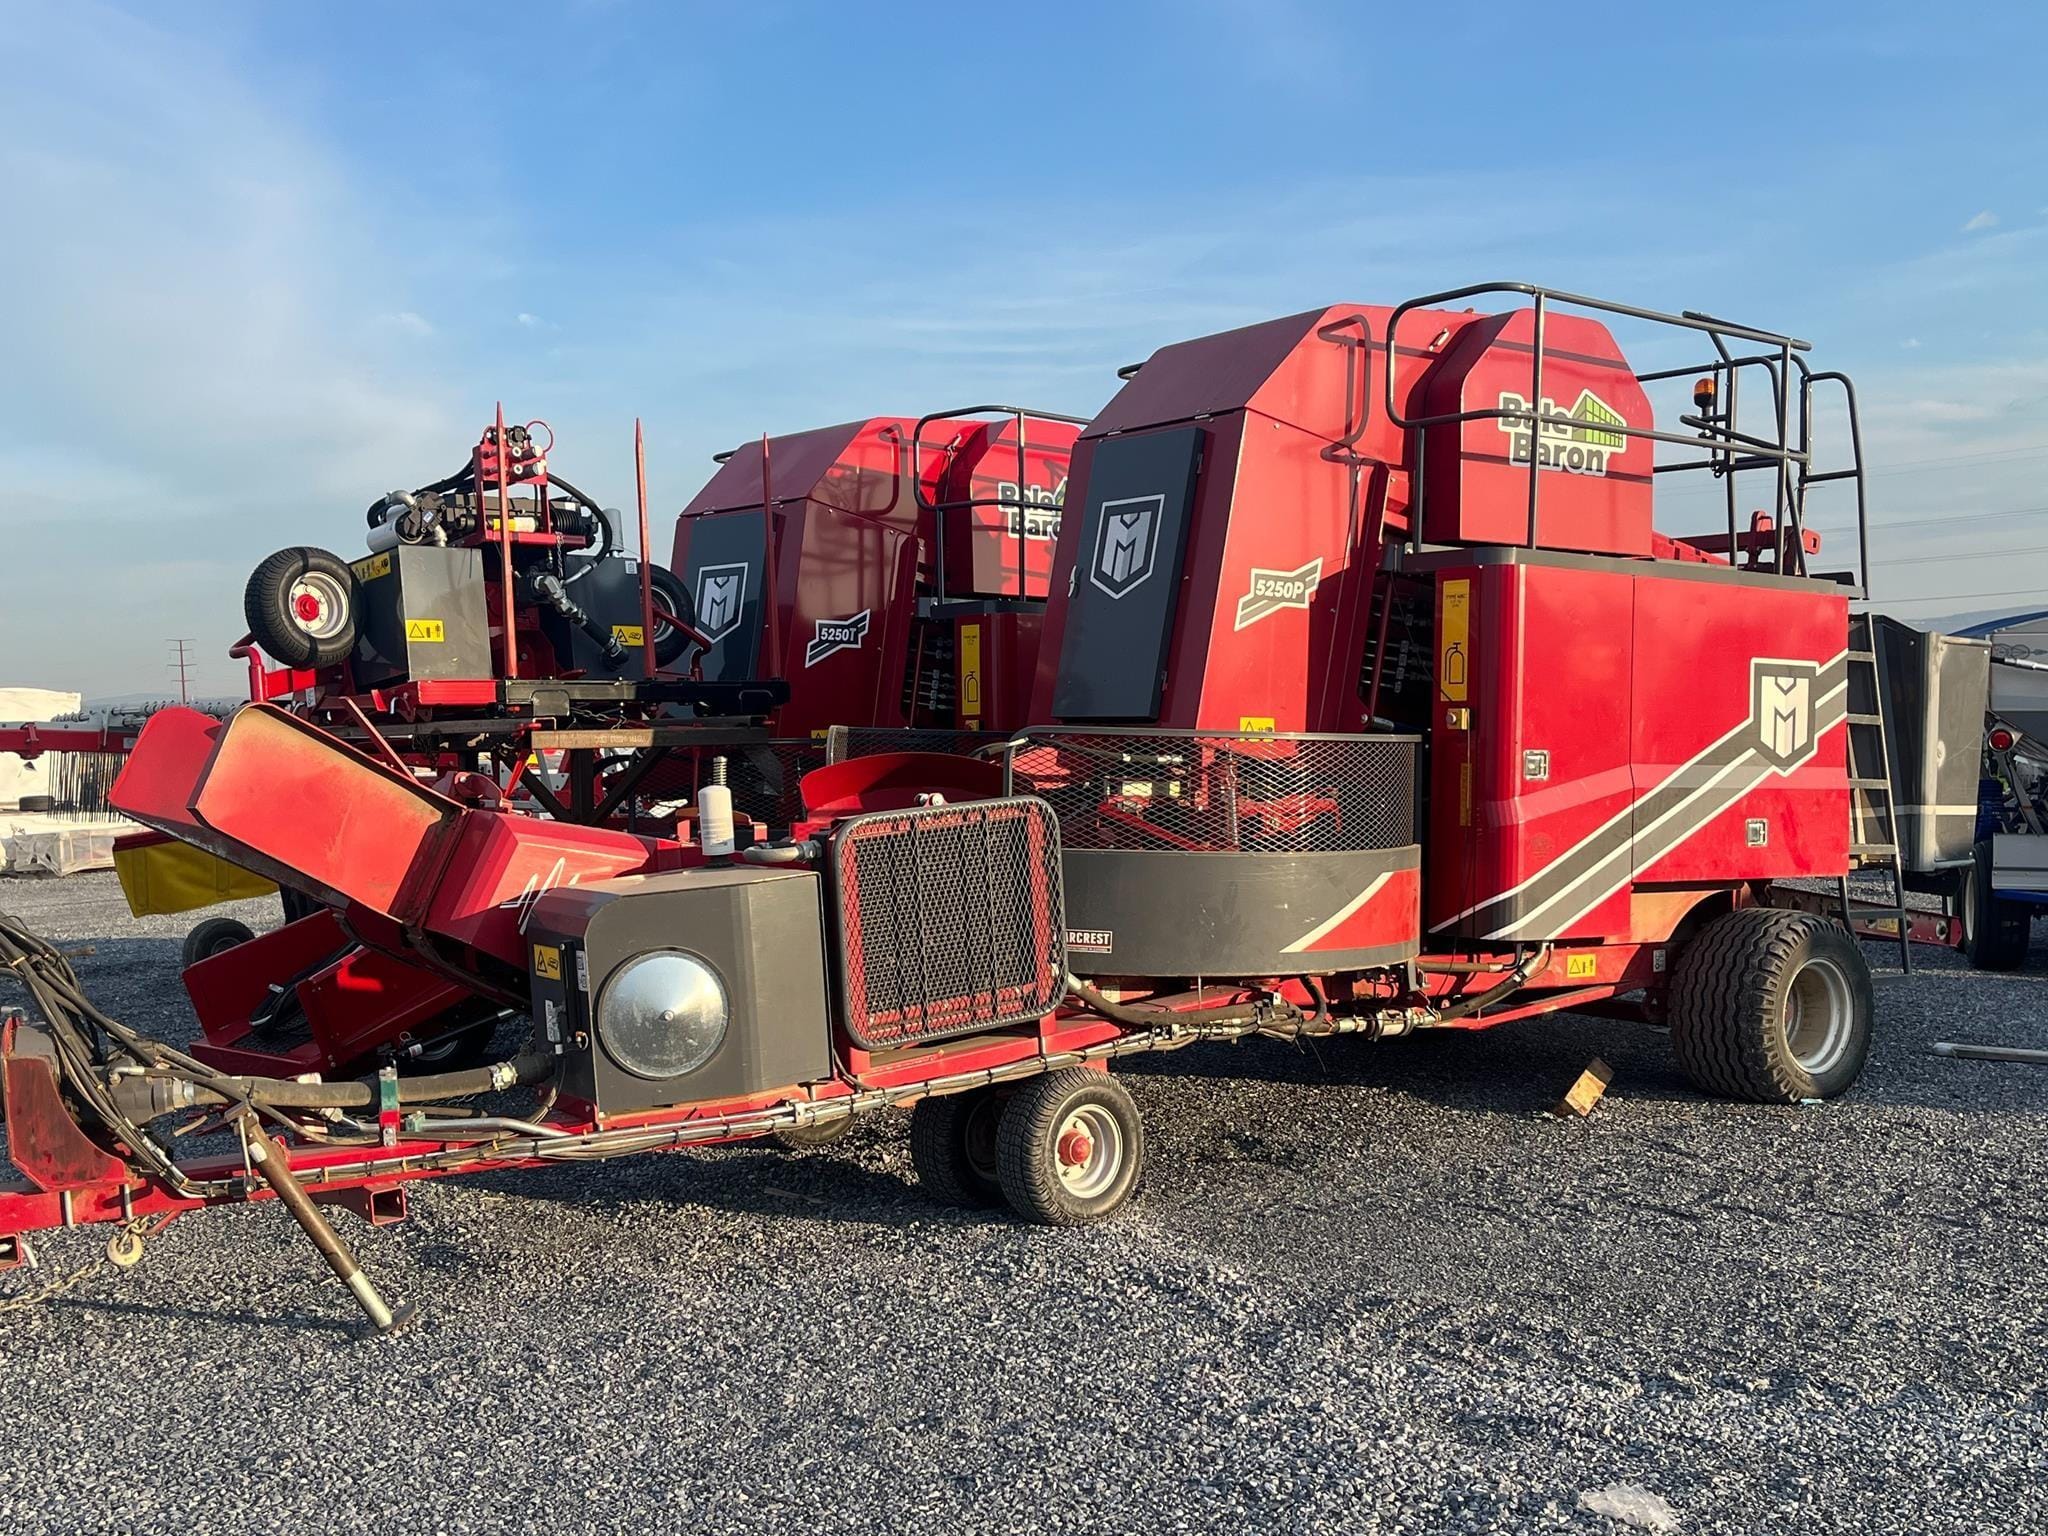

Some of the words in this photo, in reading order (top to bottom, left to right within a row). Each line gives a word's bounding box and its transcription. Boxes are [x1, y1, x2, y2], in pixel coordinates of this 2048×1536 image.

[1512, 431, 1604, 473] Baron
[1001, 485, 1053, 511] Ble
[1255, 579, 1304, 599] 5250P
[820, 627, 857, 641] 5250T
